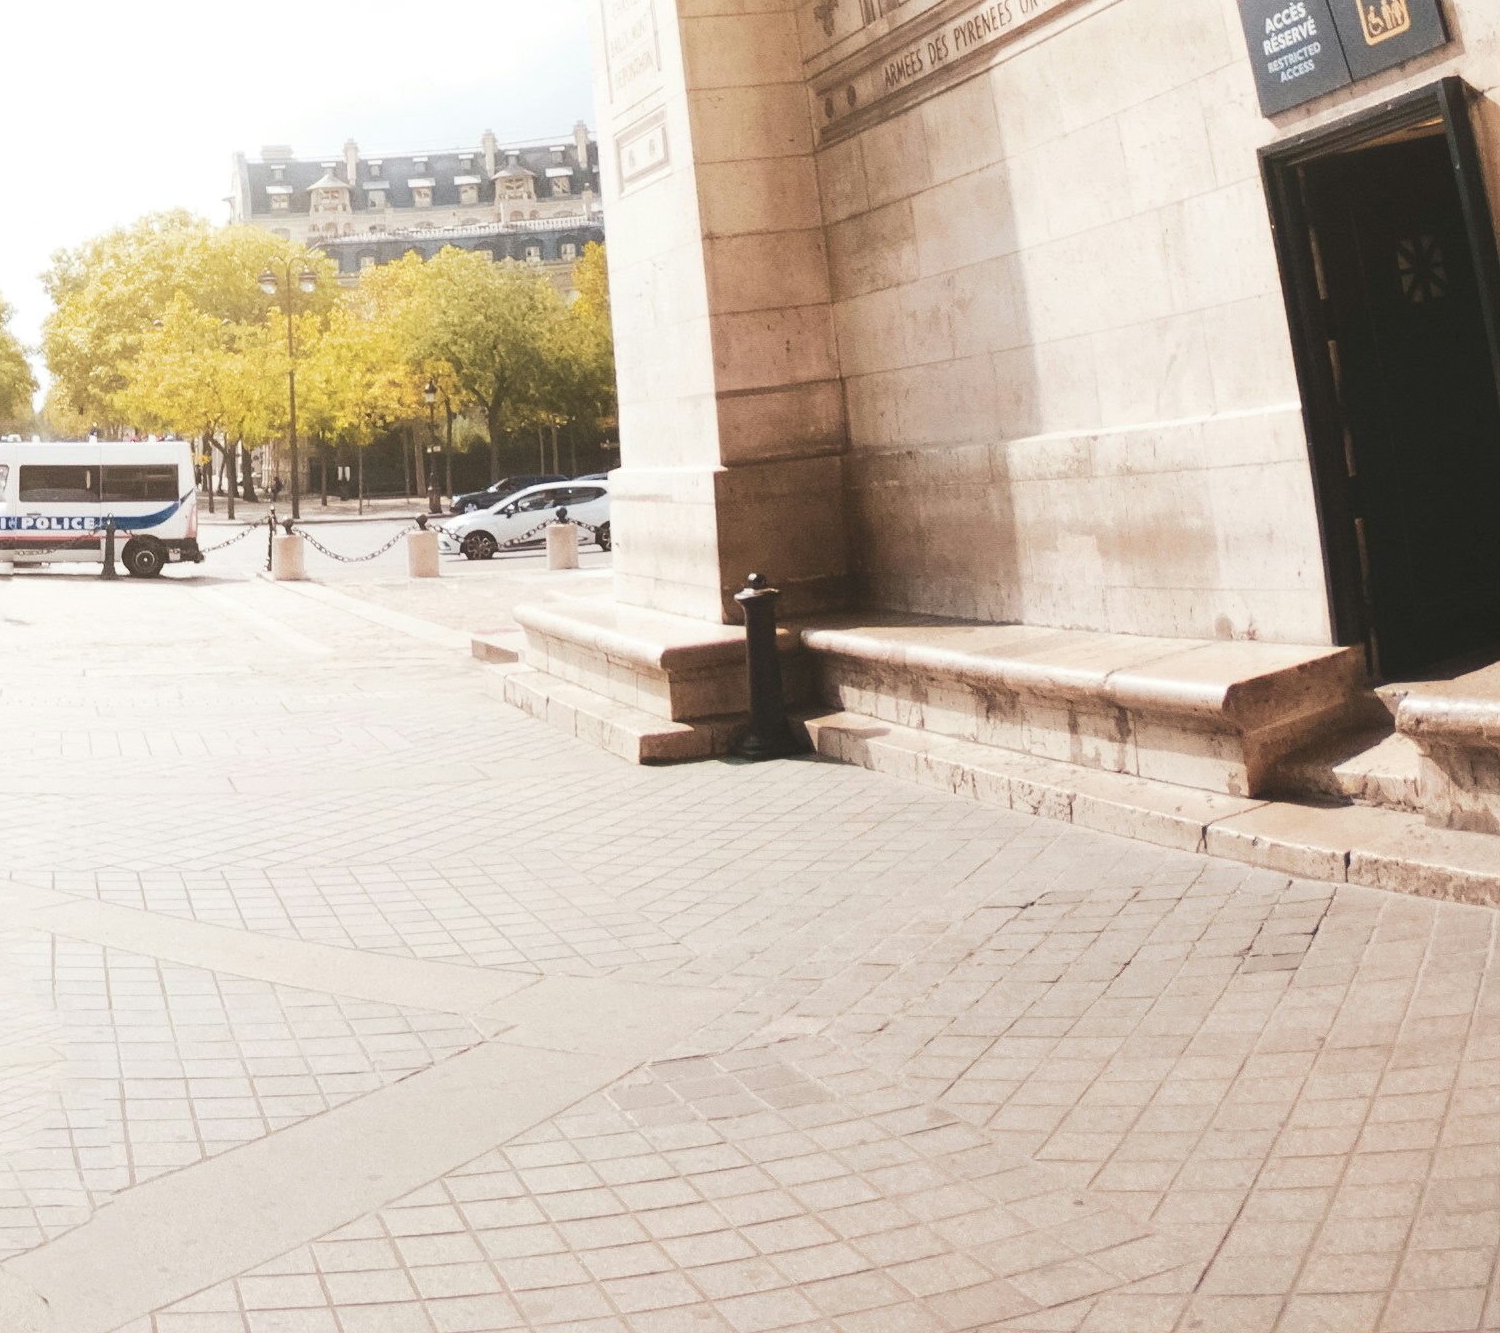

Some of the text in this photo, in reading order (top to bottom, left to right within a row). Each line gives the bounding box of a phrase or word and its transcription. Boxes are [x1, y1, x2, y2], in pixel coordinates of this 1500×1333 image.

[1264, 1, 1307, 35] ACCÈS
[1262, 15, 1318, 56] RÉSERVÉ
[1267, 41, 1322, 74] RESTRICTED
[1279, 60, 1316, 84] ACCESS
[21, 517, 95, 530] POLICE
